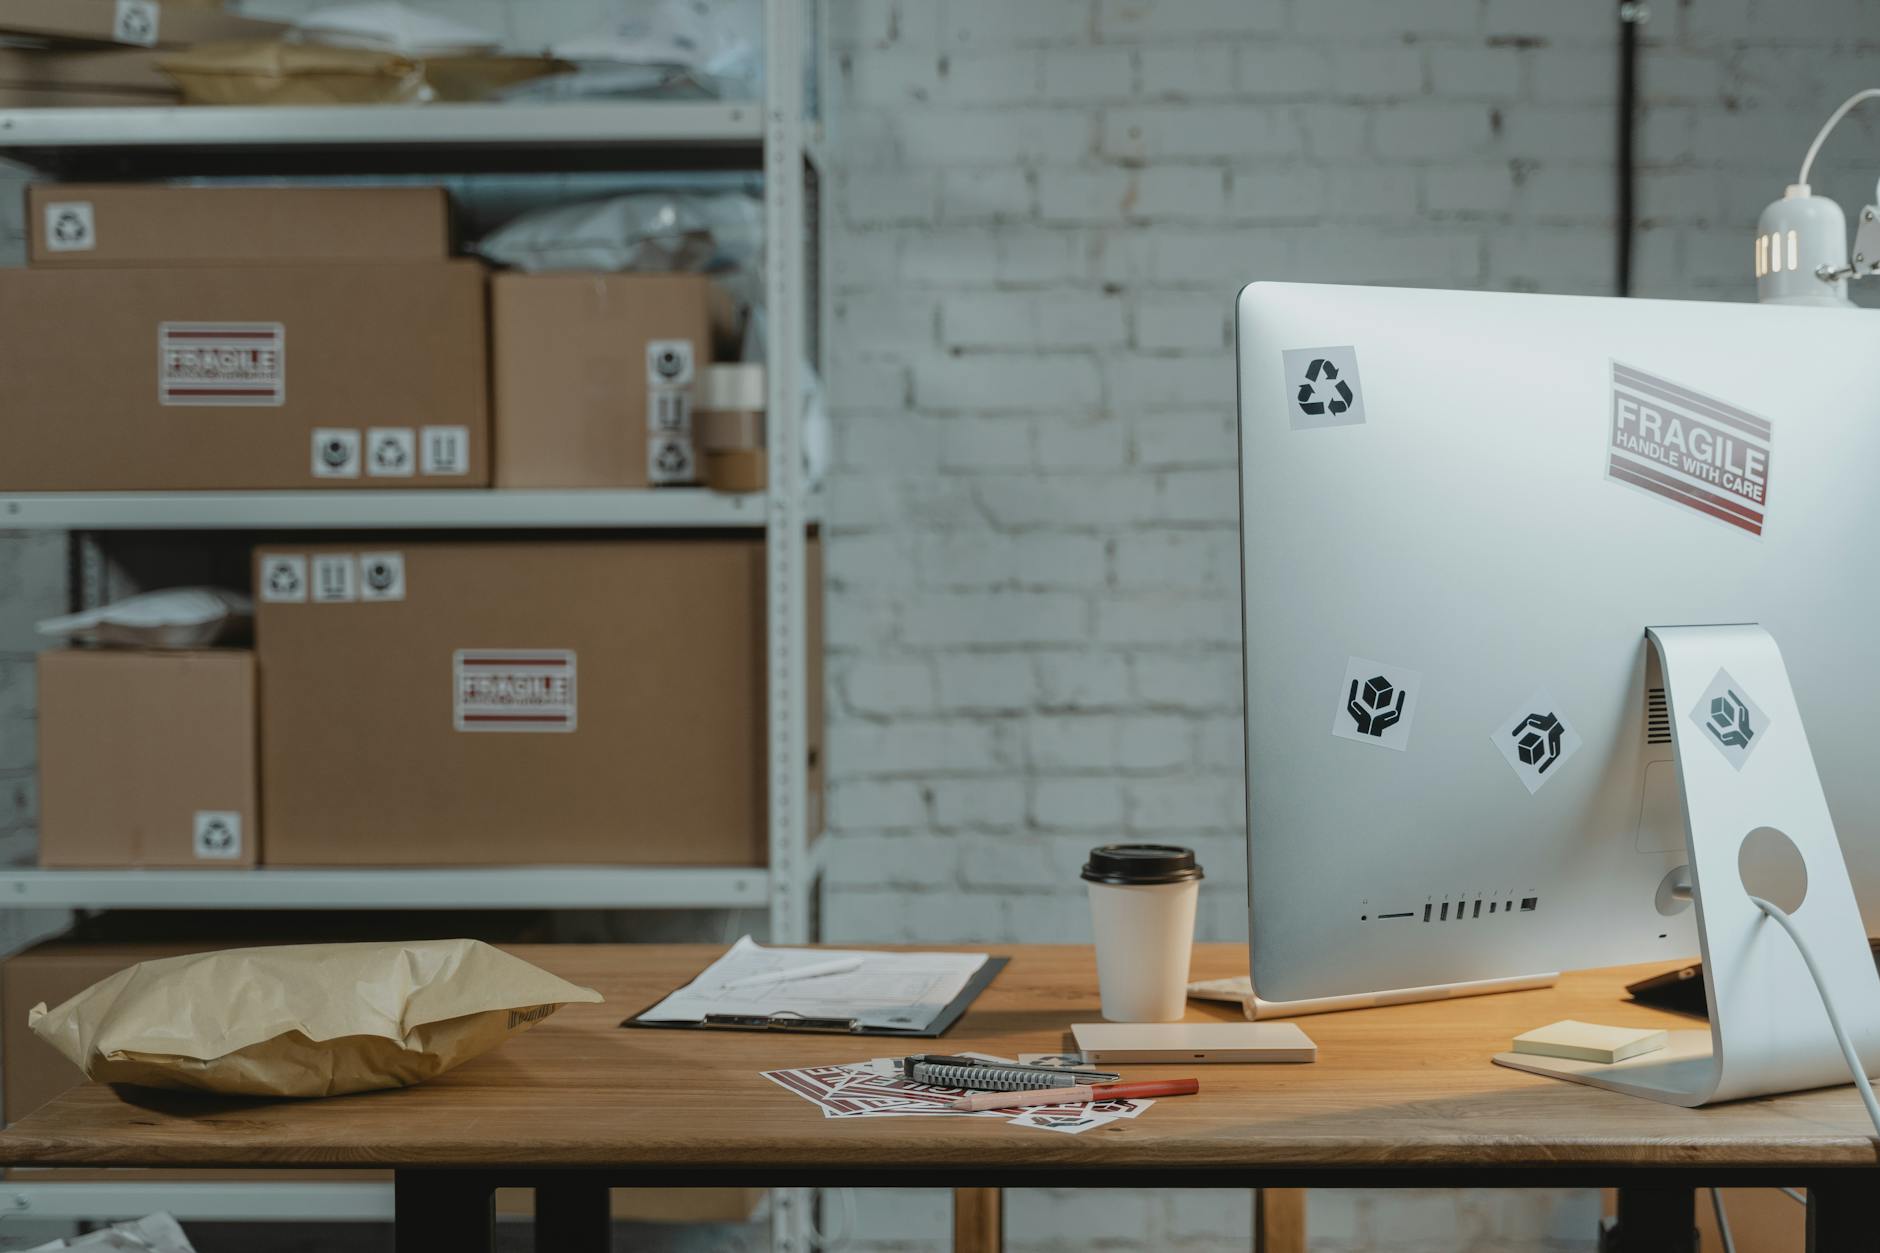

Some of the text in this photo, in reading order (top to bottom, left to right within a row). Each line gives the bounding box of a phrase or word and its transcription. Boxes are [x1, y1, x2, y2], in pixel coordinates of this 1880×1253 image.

[1616, 429, 1764, 502] HANDLE WITH CARE
[1617, 398, 1766, 486] FRAGILE
